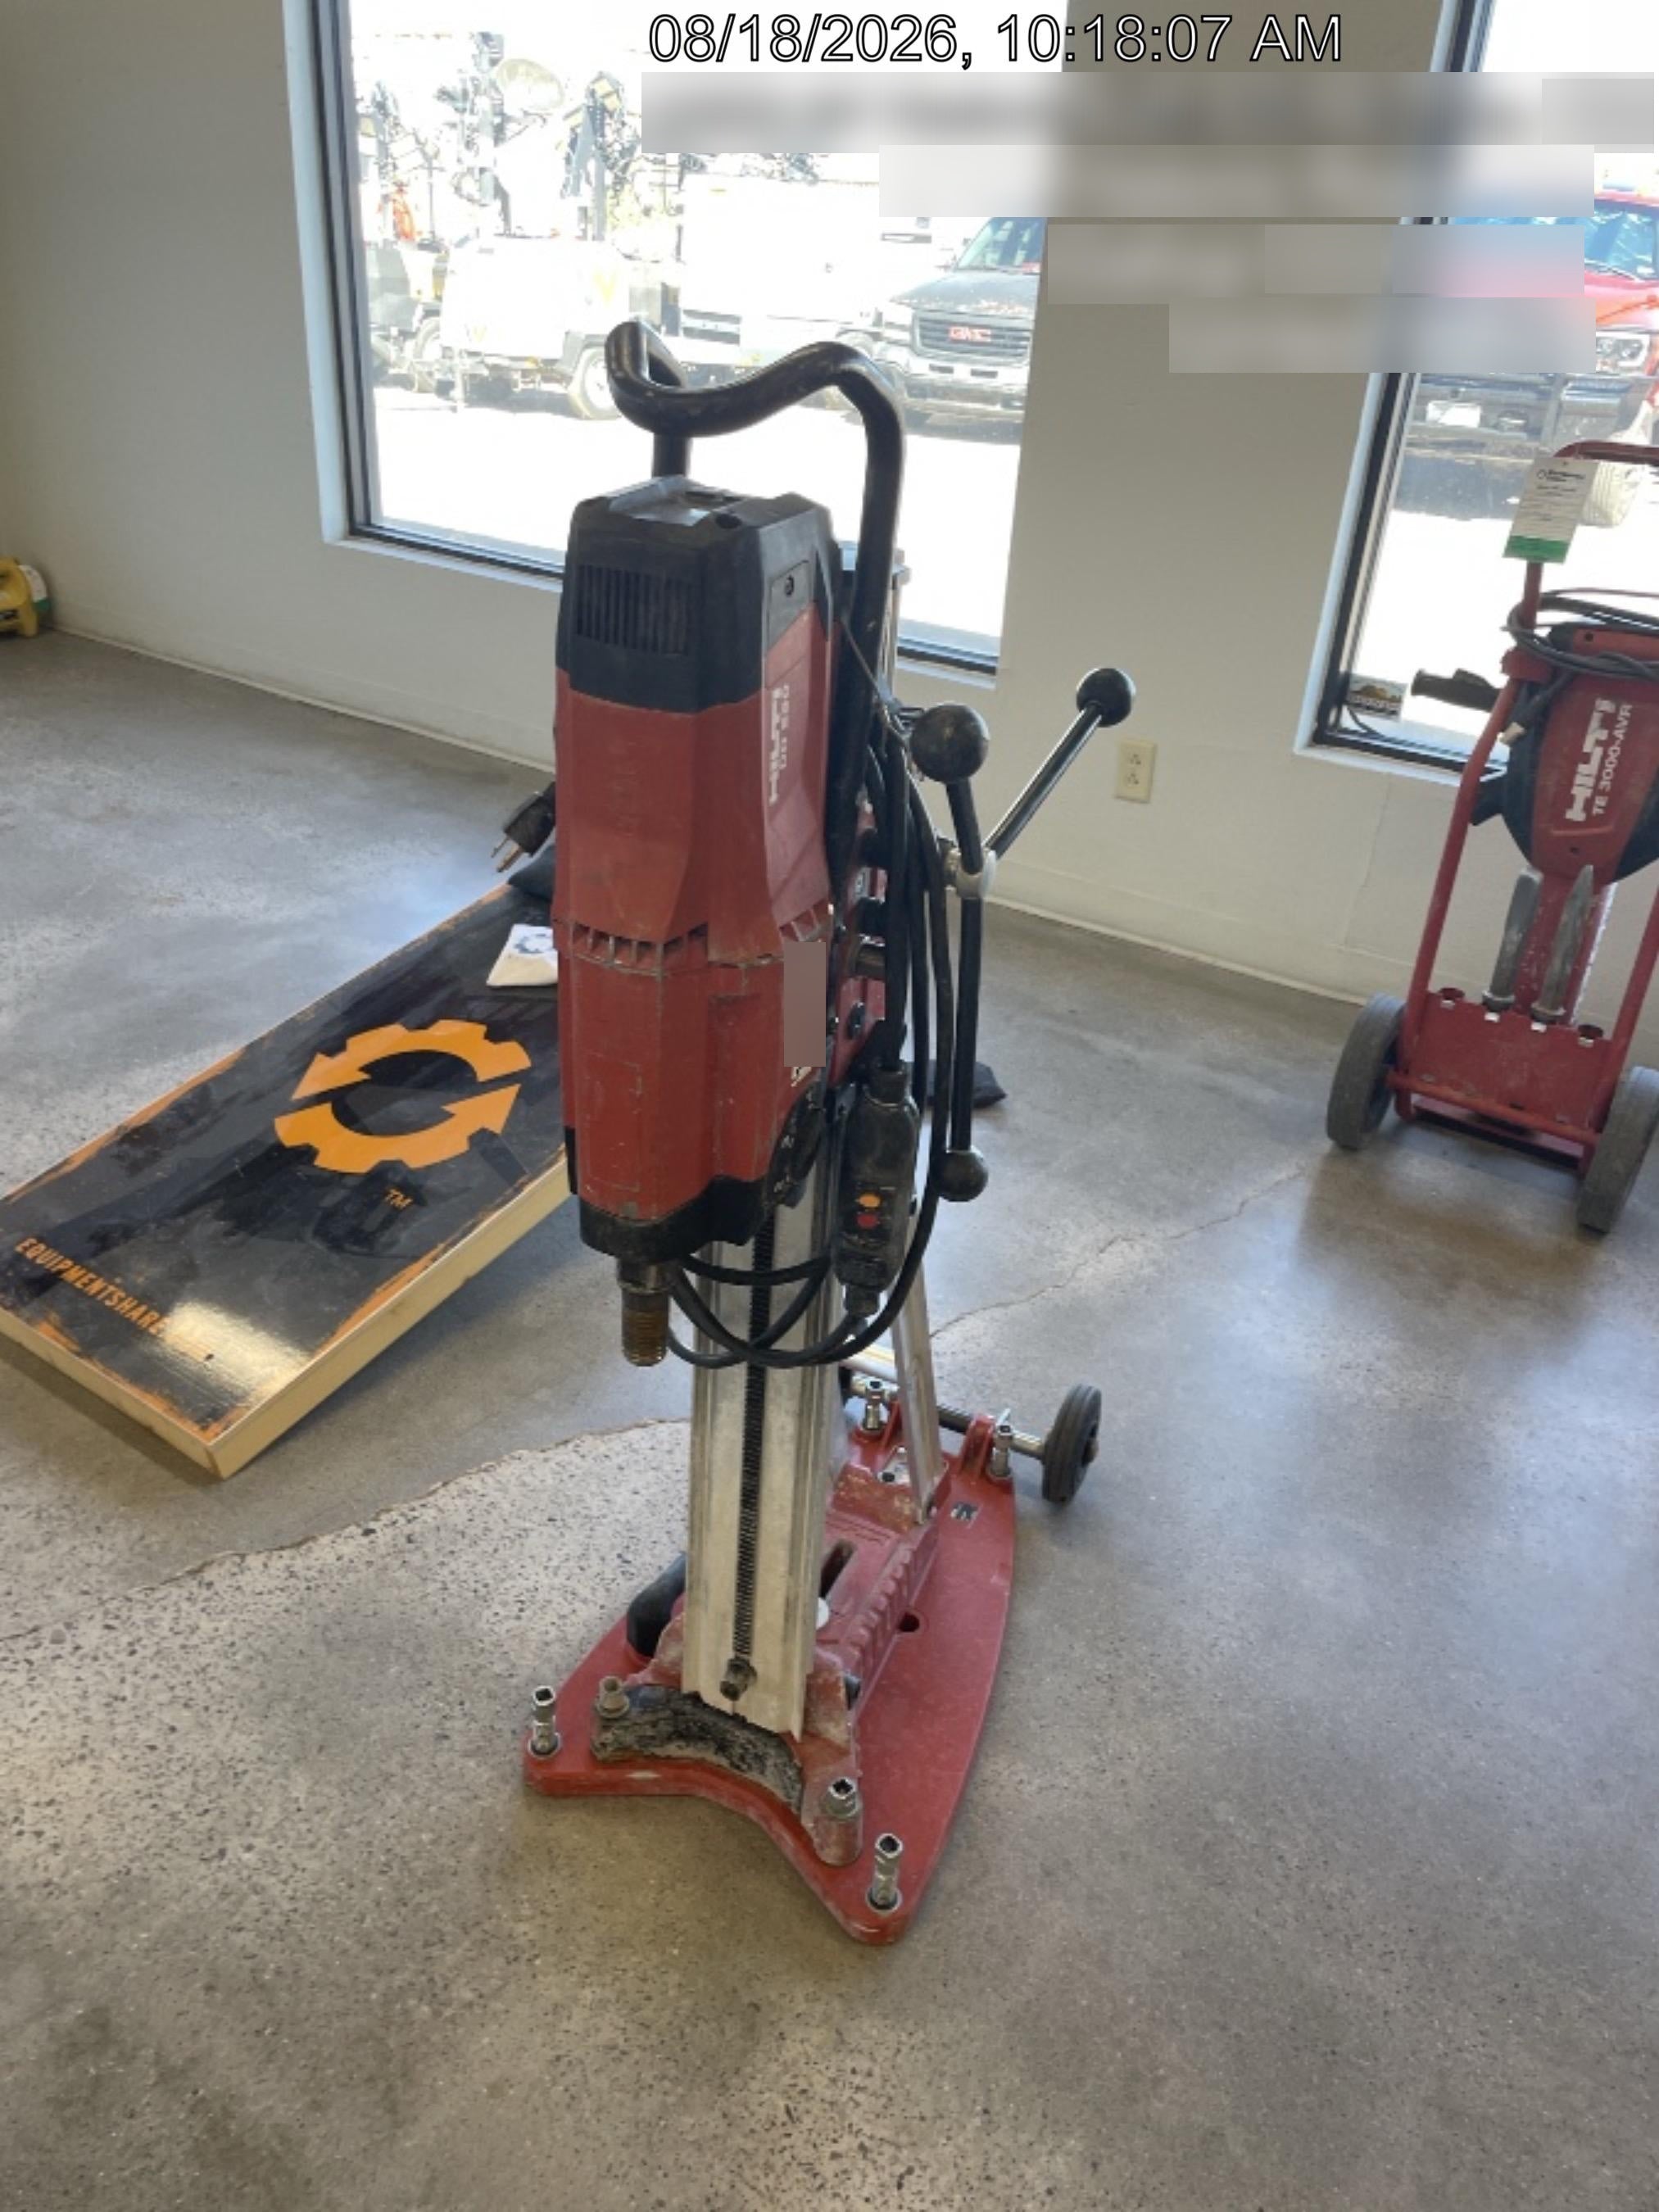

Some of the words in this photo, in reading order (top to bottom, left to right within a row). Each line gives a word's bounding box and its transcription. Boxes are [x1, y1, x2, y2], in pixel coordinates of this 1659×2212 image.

[950, 327, 991, 342] GMC
[1566, 698, 1616, 822] HILTI
[1599, 704, 1633, 792] 3000-AVR
[1592, 796, 1609, 816] TE
